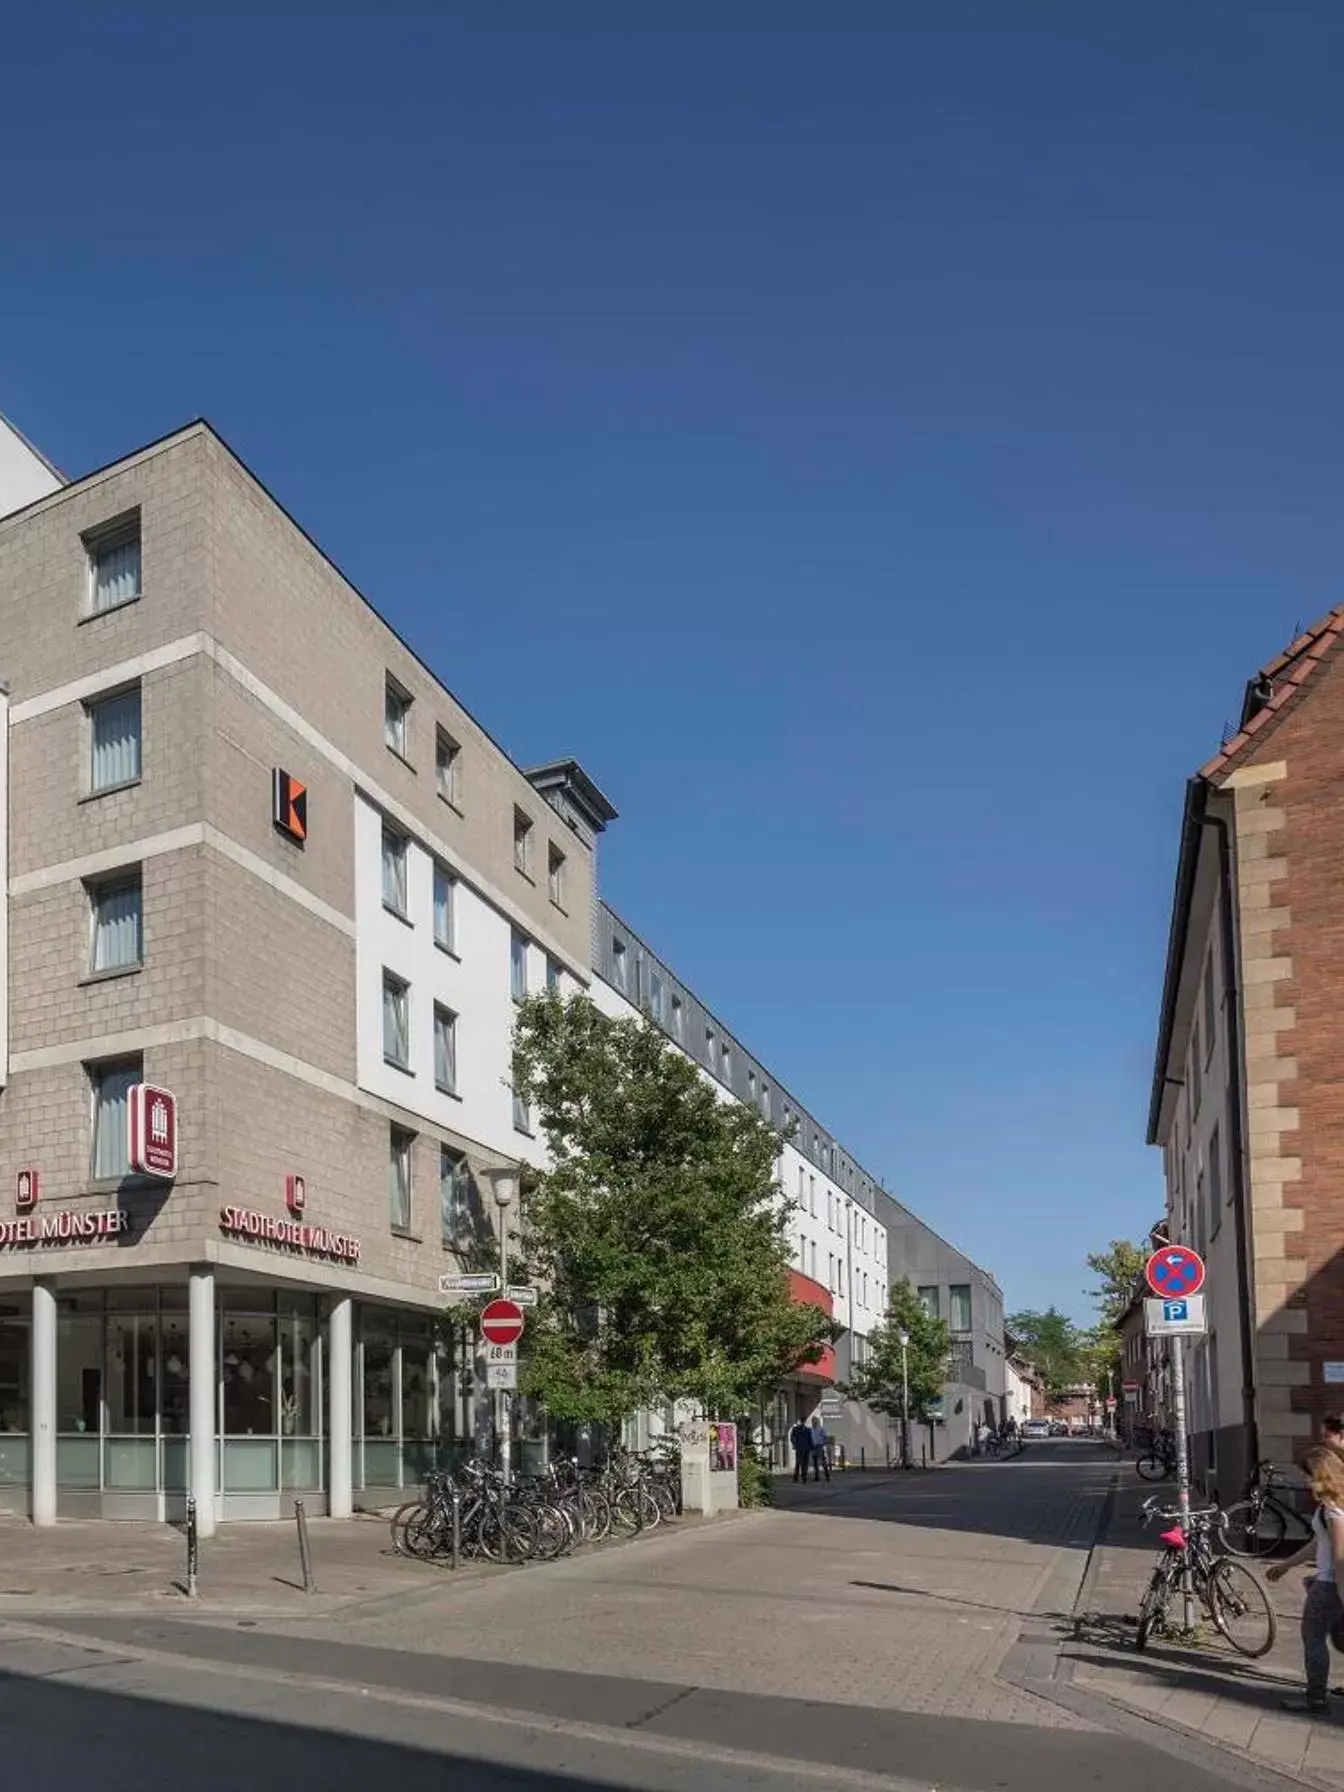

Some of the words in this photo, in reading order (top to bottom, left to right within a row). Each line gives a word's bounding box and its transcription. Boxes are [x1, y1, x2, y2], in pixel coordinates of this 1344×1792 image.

[41, 1209, 129, 1239] MÜNSTER
[225, 1205, 306, 1247] STADTHOTEL
[1169, 1305, 1182, 1320] P
